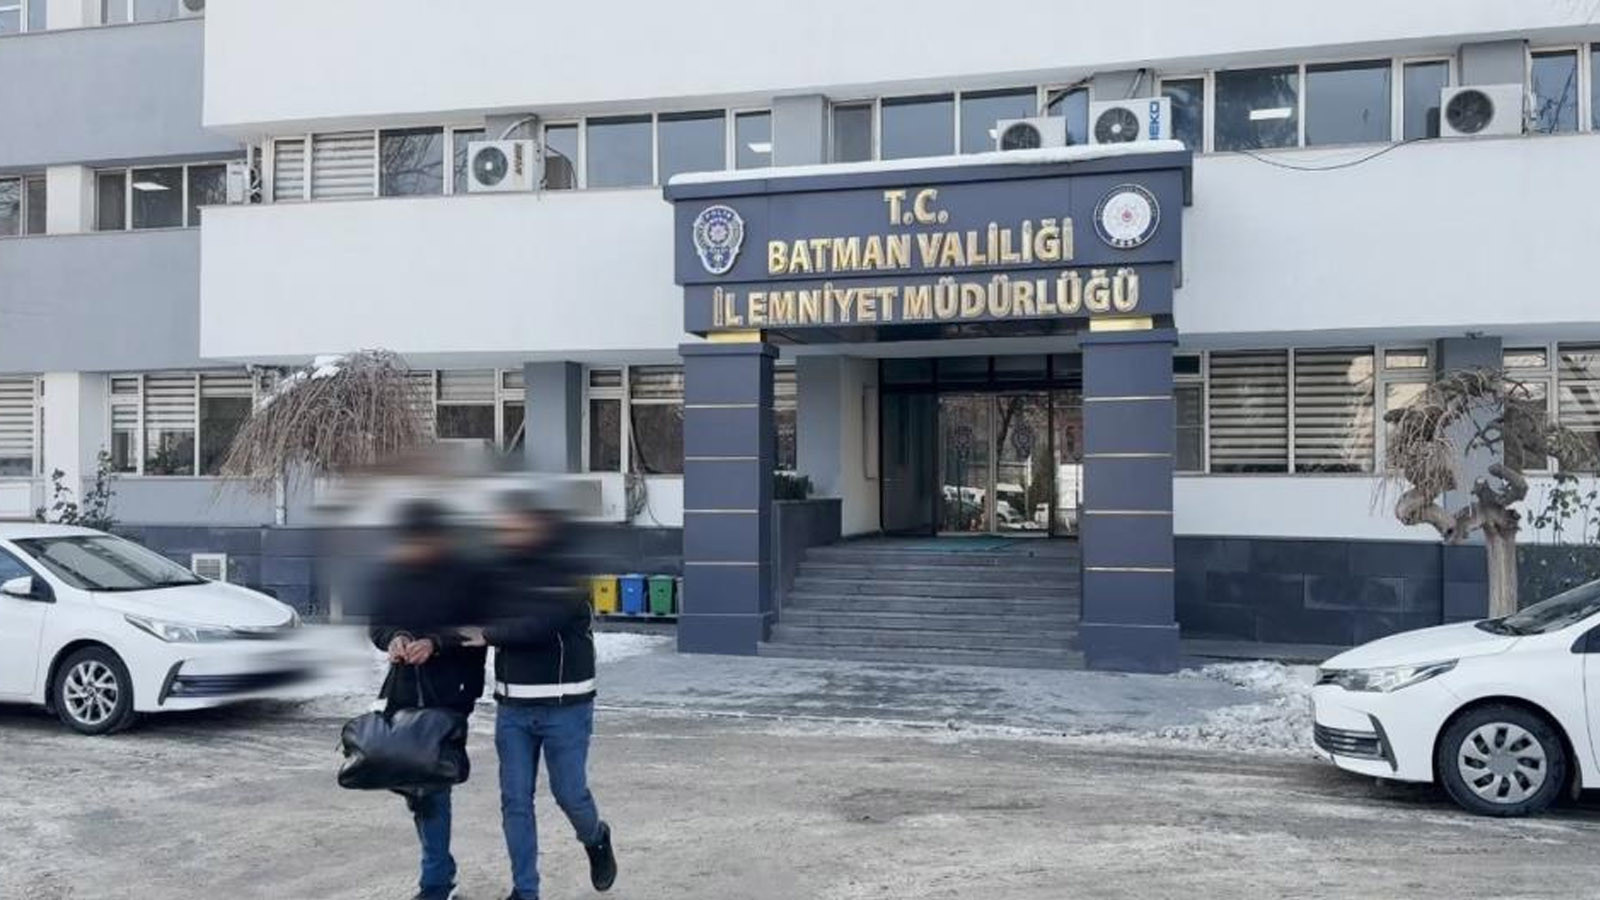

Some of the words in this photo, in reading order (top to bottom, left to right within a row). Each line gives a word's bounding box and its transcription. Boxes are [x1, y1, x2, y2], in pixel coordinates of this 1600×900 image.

[1149, 101, 1160, 140] EKO
[884, 189, 949, 224] T.C.
[768, 234, 911, 274] BATMAN
[917, 217, 1073, 268] VALİLİĞİ
[713, 285, 743, 327] İL
[749, 282, 899, 325] EMNİYET
[902, 267, 1139, 320] MÜDÜRLÜĞÜ
